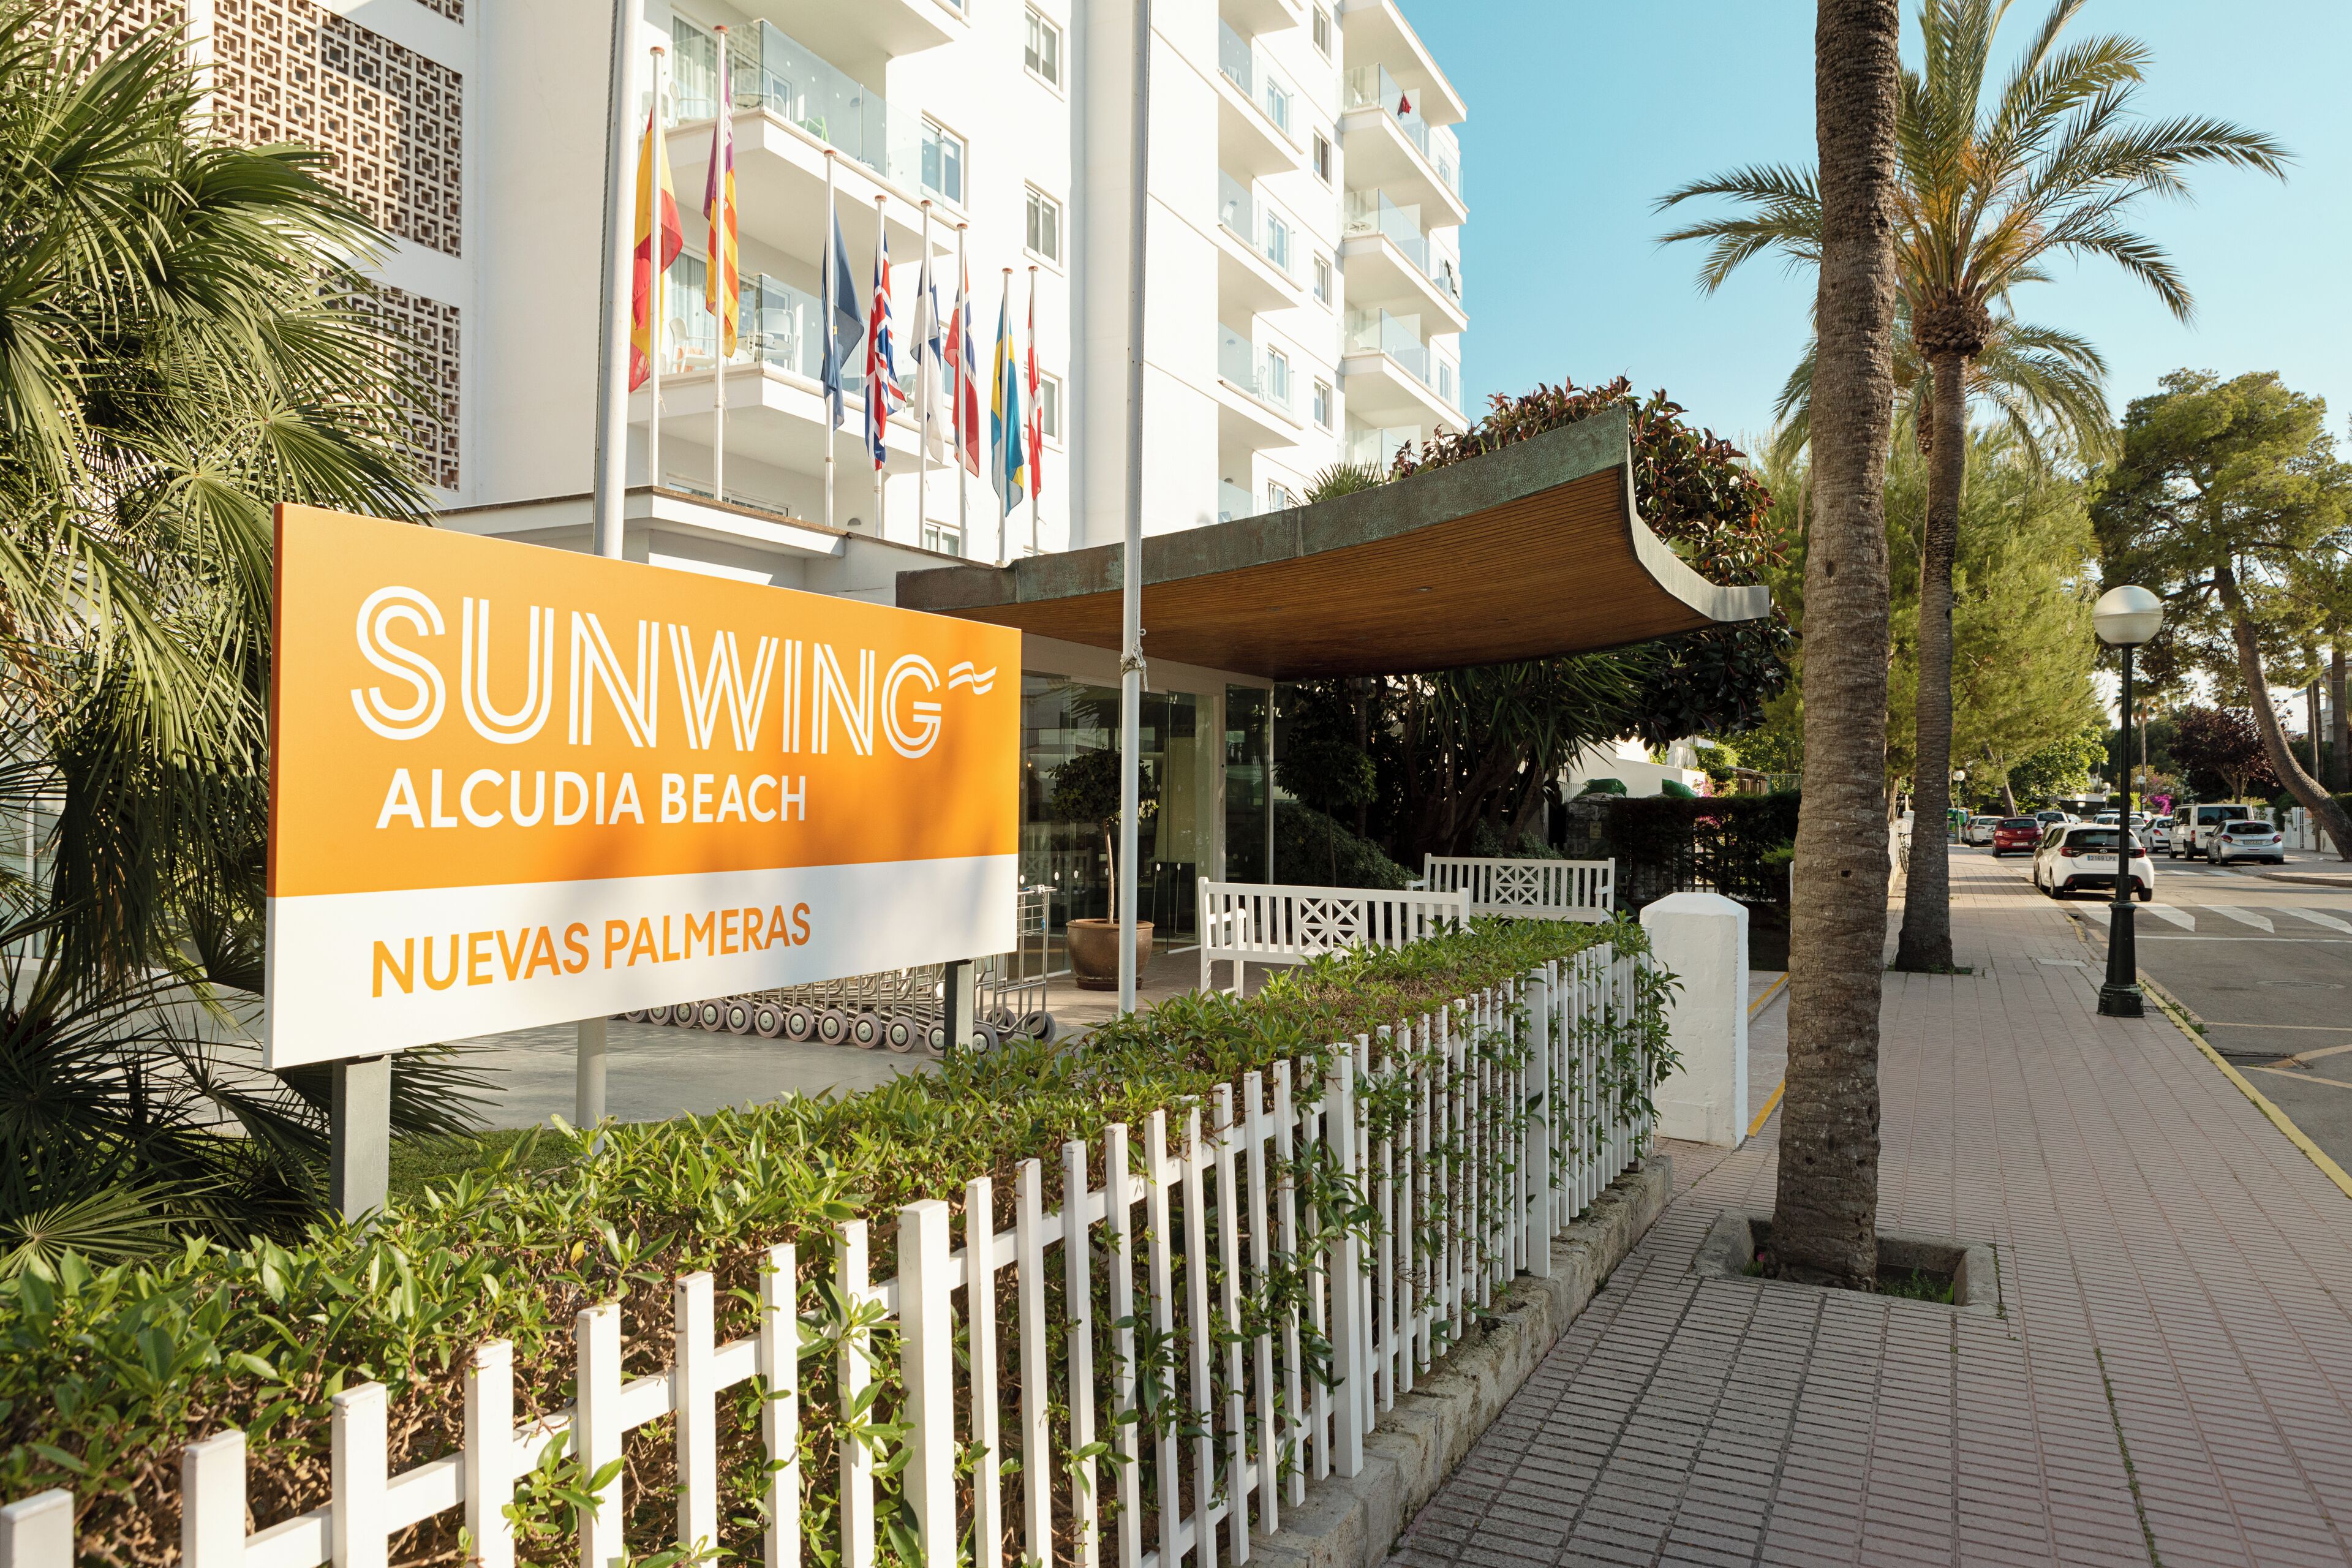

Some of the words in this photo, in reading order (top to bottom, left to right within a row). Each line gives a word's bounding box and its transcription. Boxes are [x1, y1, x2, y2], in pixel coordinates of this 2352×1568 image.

[350, 585, 942, 759] SUNWING
[375, 768, 644, 829] ALCUDIA
[661, 773, 806, 824] BEACH
[372, 922, 590, 998] NUEVAS
[604, 902, 810, 970] PALMERAS
